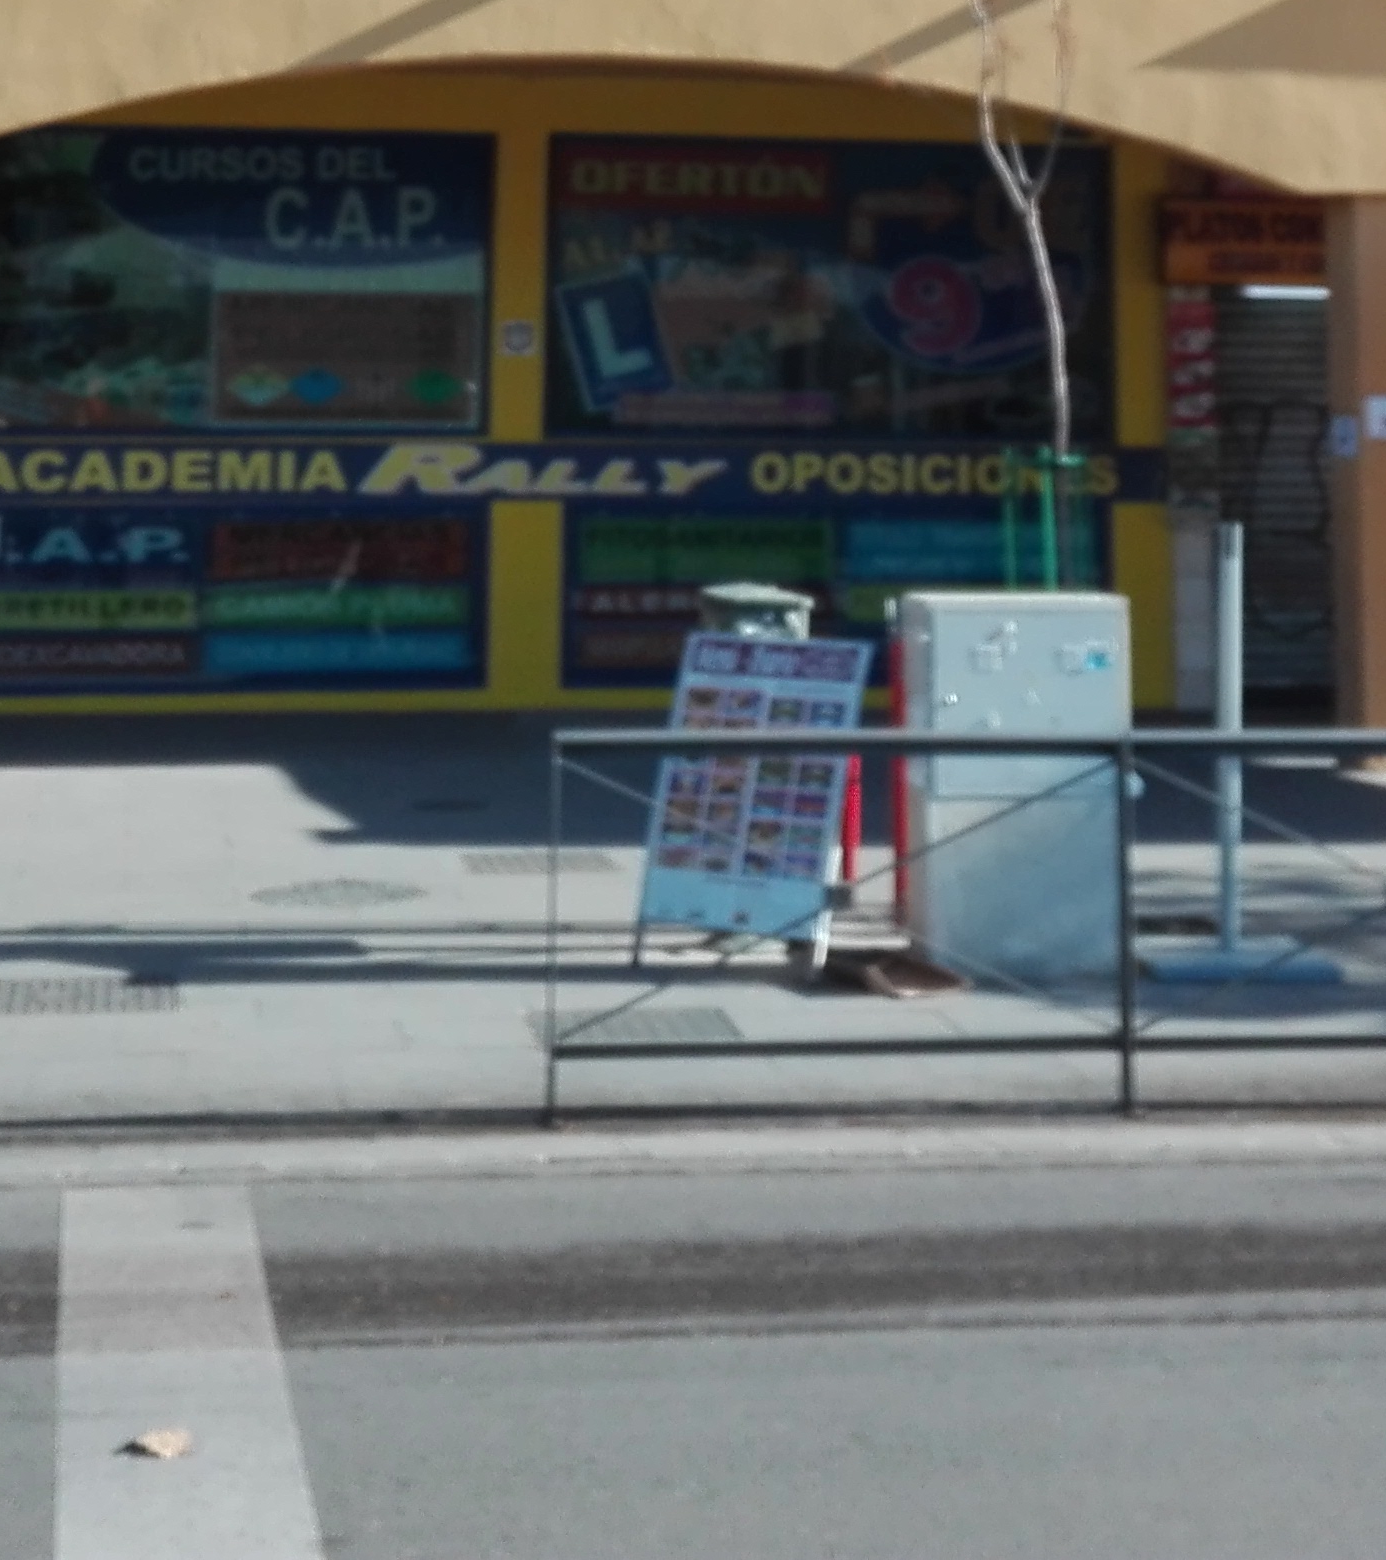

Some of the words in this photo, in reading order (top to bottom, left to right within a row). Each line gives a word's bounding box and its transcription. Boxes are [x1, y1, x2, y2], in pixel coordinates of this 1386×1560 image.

[128, 145, 303, 181] CURSOS
[318, 148, 397, 181] DEL
[264, 187, 445, 252] C.A.P.
